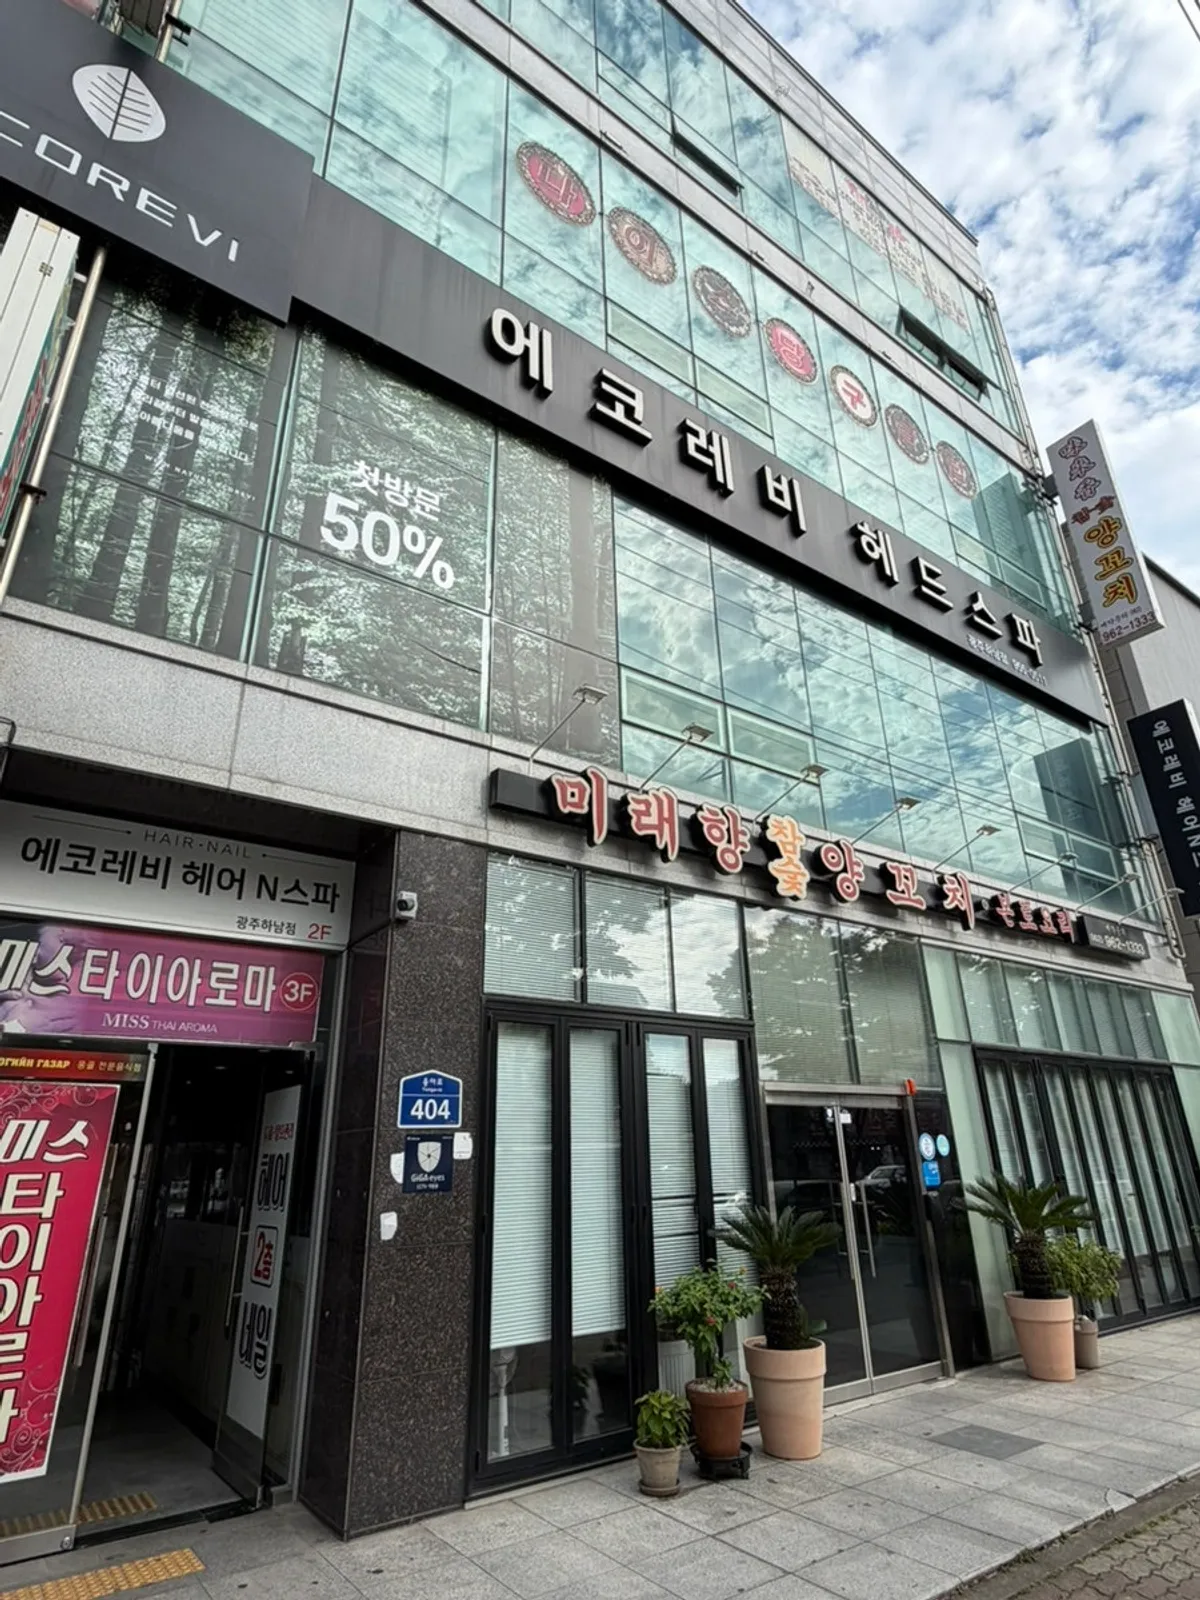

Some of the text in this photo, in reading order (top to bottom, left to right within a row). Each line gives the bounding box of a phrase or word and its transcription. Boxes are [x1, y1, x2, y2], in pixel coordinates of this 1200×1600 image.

[351, 459, 441, 522] 첫방문
[491, 308, 1043, 666] 에코레비 헤드스파
[320, 492, 456, 590] 50%
[1084, 515, 1139, 608] 양꼬치
[1102, 610, 1156, 643] 962-1333
[20, 836, 340, 914] 에코레비 헤어 N스파
[552, 766, 750, 874] 미래향
[819, 838, 975, 931] 양꼬치
[236, 915, 332, 940] 광주하남점 2F
[284, 981, 314, 1002] 3F
[102, 1012, 219, 1033] MISS THAI AROMA
[410, 1098, 451, 1120] 404
[0, 1119, 89, 1162] 미스
[257, 1152, 290, 1211] 헤어
[254, 1232, 275, 1281] 2층
[238, 1301, 273, 1378] 네일
